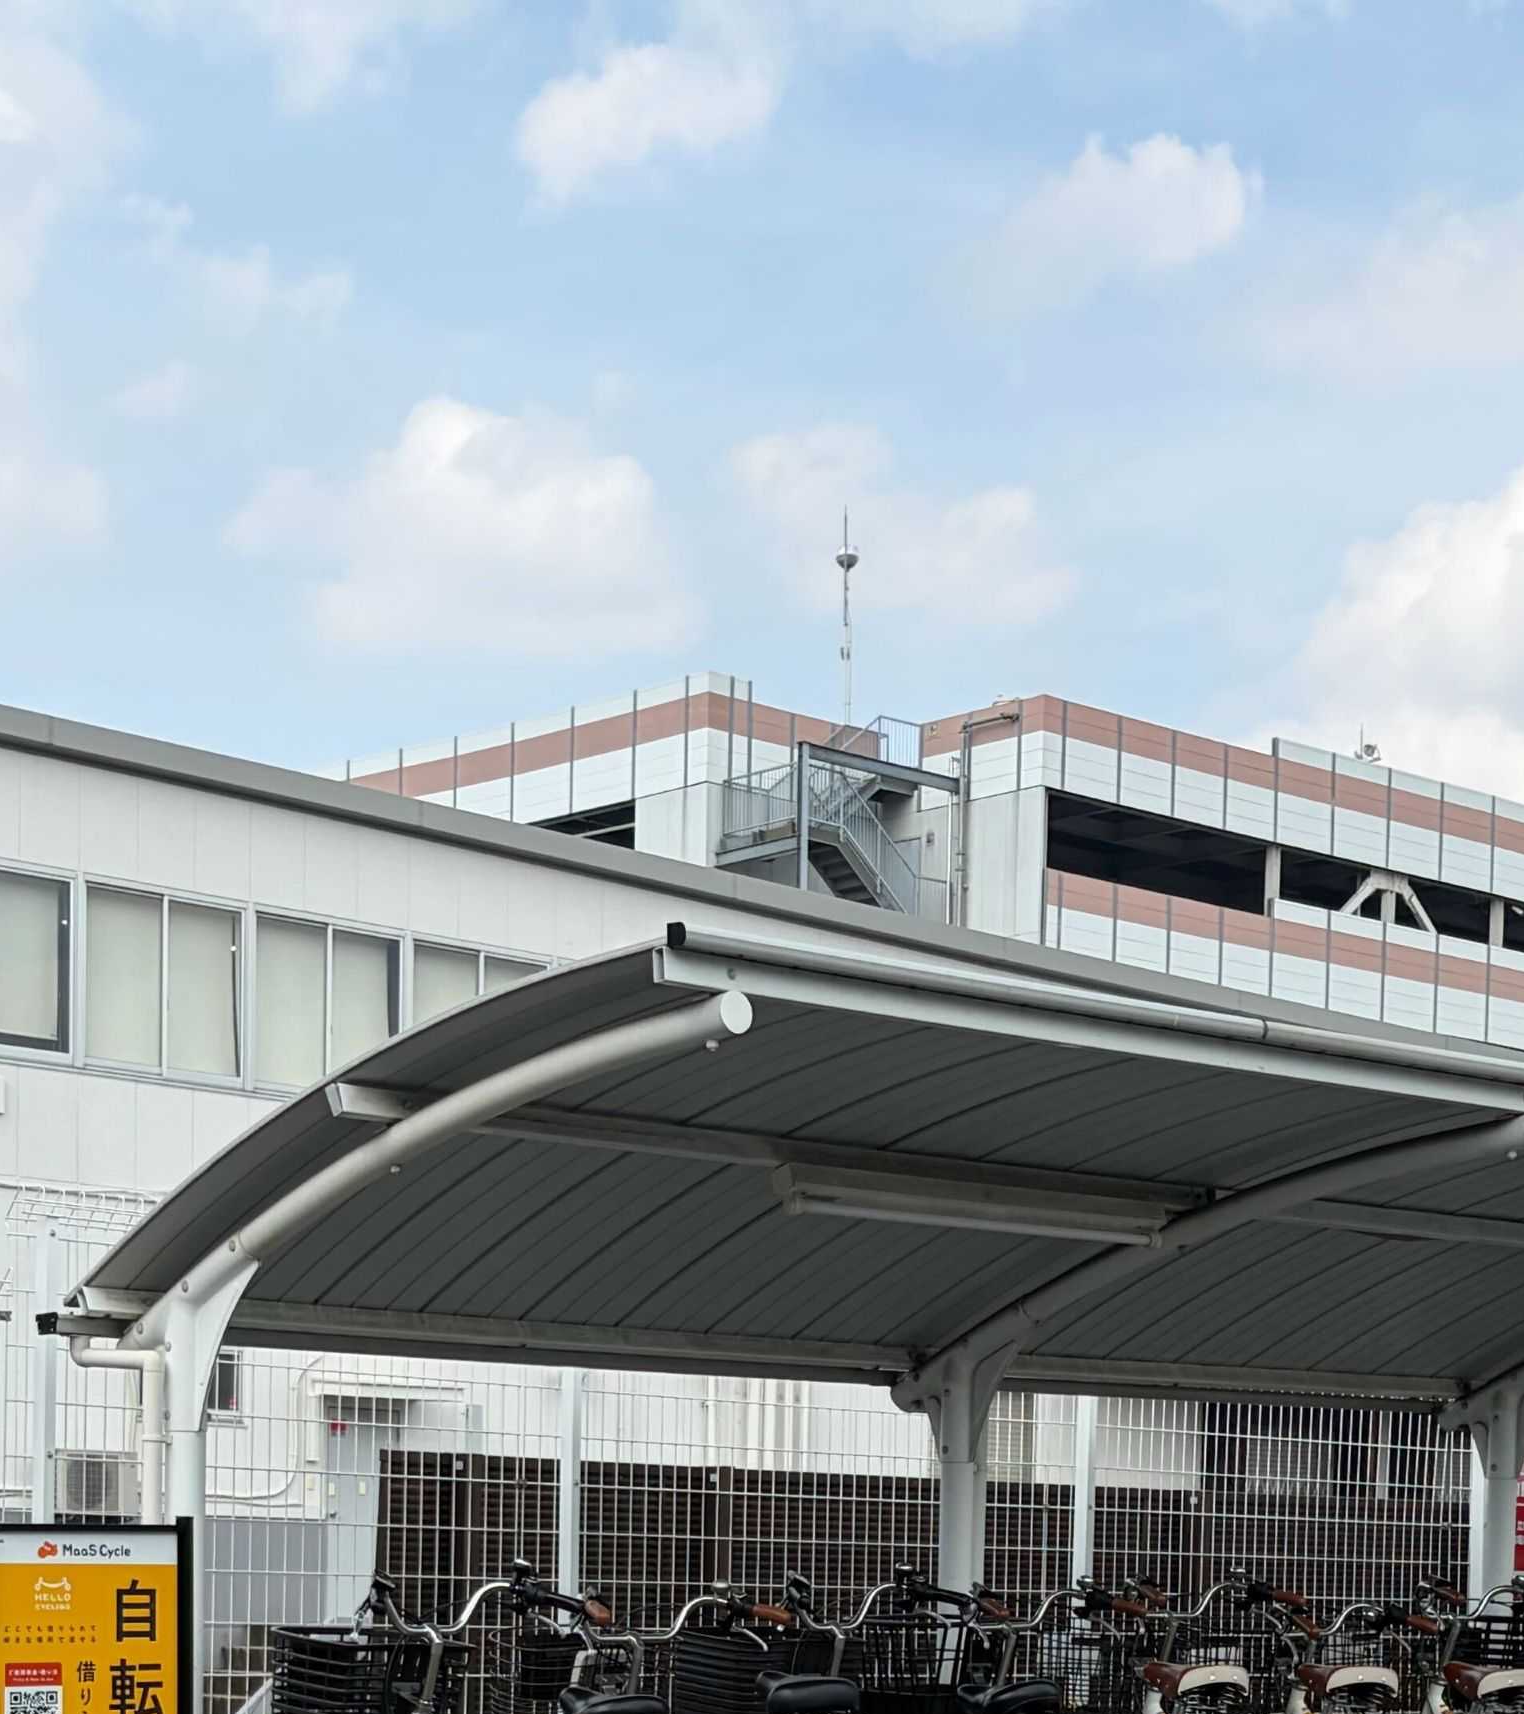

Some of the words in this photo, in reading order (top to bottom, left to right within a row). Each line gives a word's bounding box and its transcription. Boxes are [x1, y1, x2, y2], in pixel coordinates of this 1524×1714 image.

[62, 1544, 97, 1558] MaaS
[99, 1544, 131, 1559] Cycle
[34, 1593, 71, 1602] HELLO
